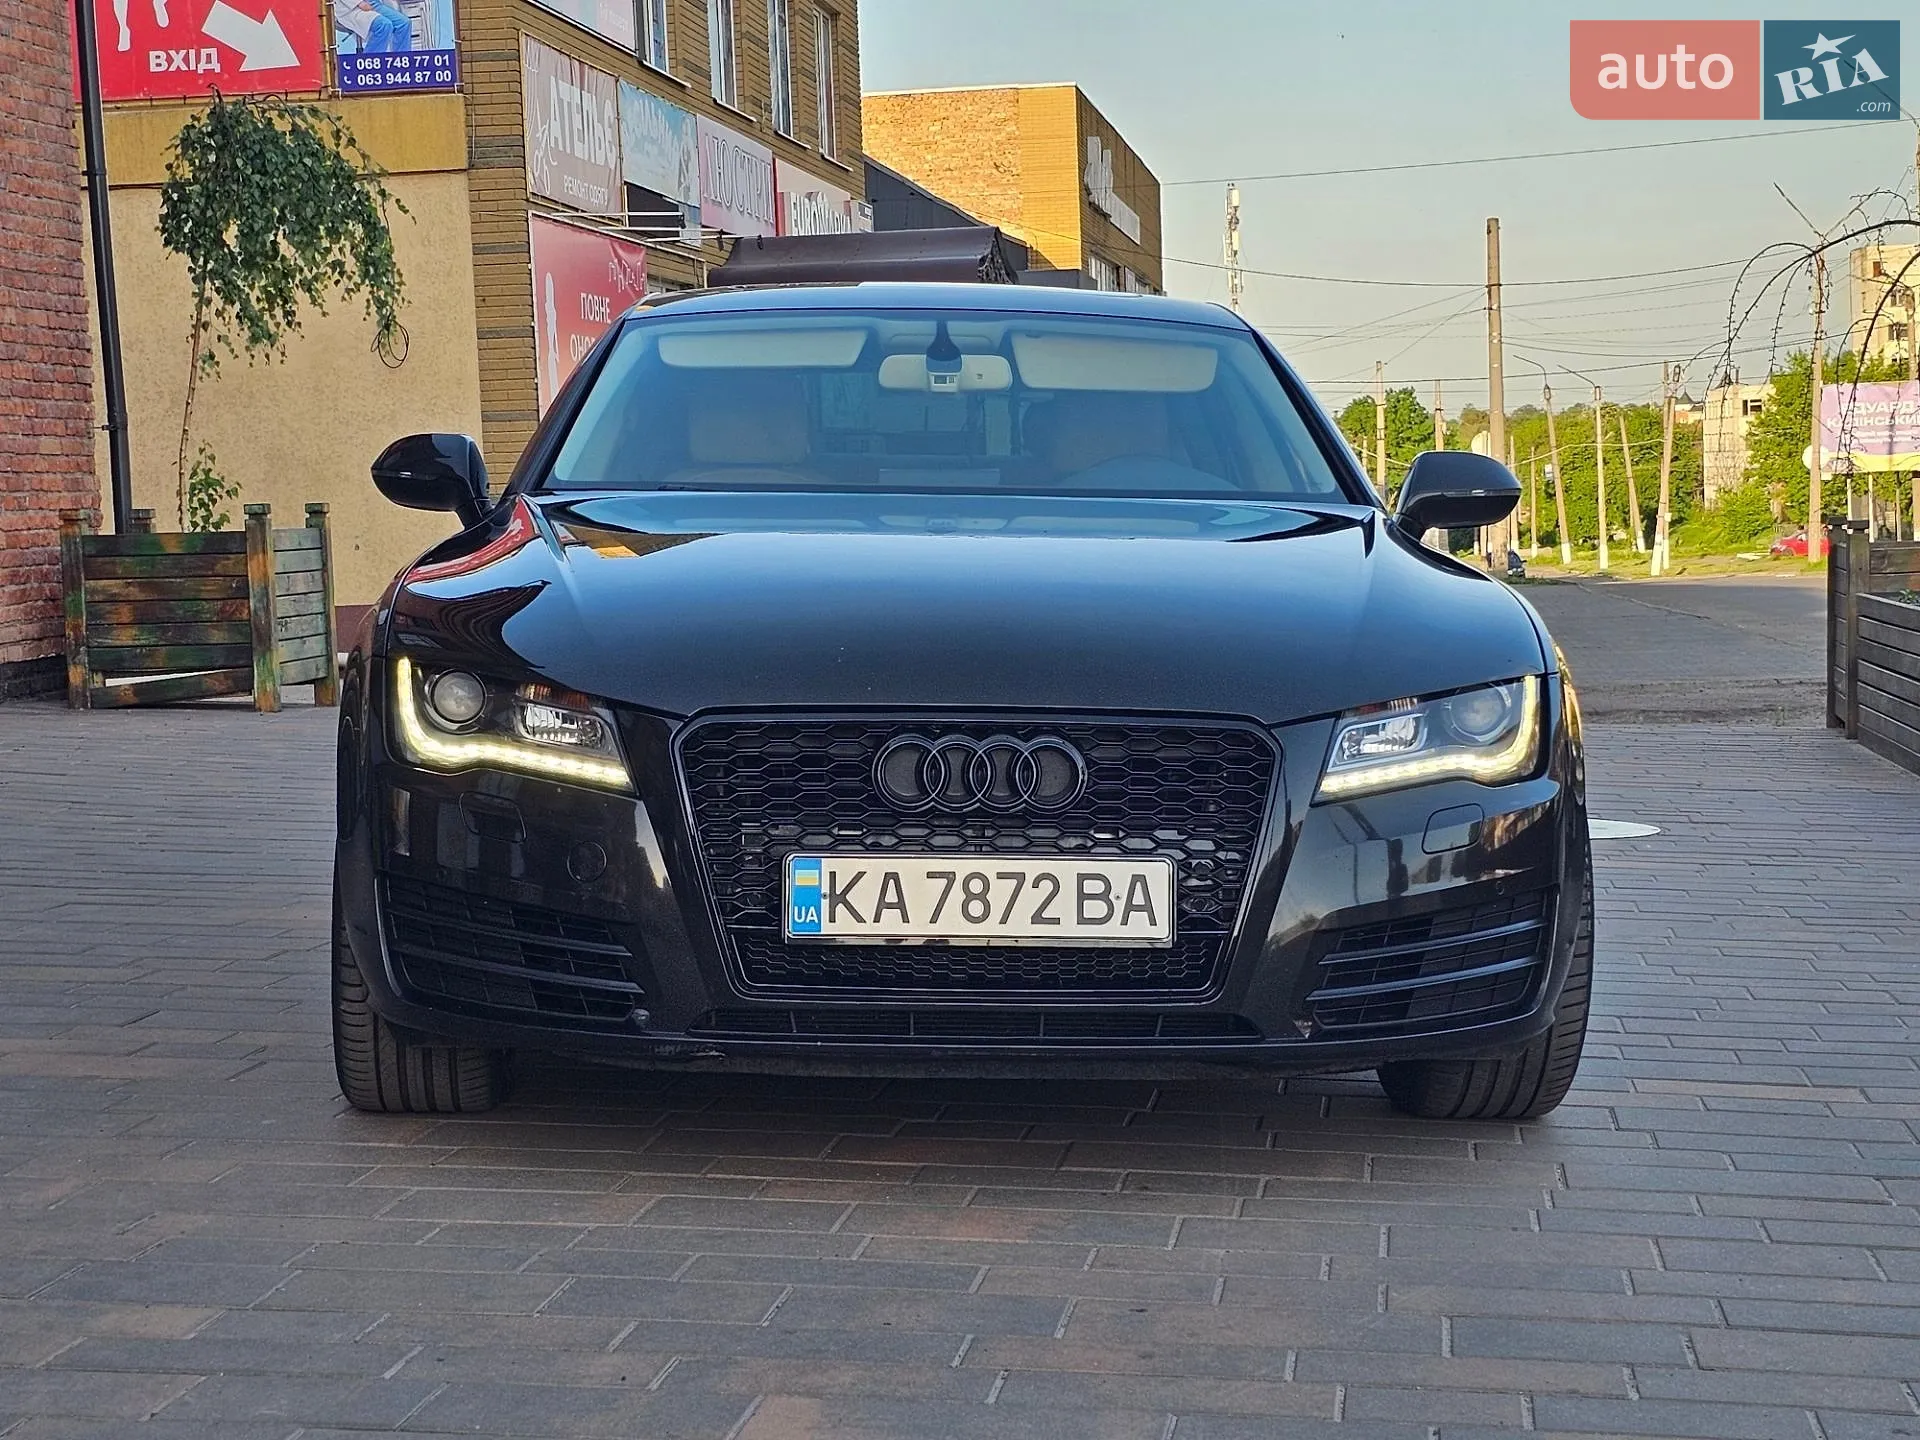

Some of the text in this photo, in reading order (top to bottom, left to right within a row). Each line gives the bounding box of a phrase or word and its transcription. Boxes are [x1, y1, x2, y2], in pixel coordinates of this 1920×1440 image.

[148, 47, 221, 74] ВХІД
[356, 54, 450, 70] 068 748 77 01
[357, 70, 452, 86] 063 944 87 00
[550, 75, 617, 170] АТЕЛЬЄ
[703, 132, 775, 225] ЛЮСТРИ
[580, 292, 612, 325] ПОВНЕ
[570, 334, 596, 362] ОНО
[828, 871, 1158, 927] KA 7872 BA
[793, 904, 819, 924] UA
